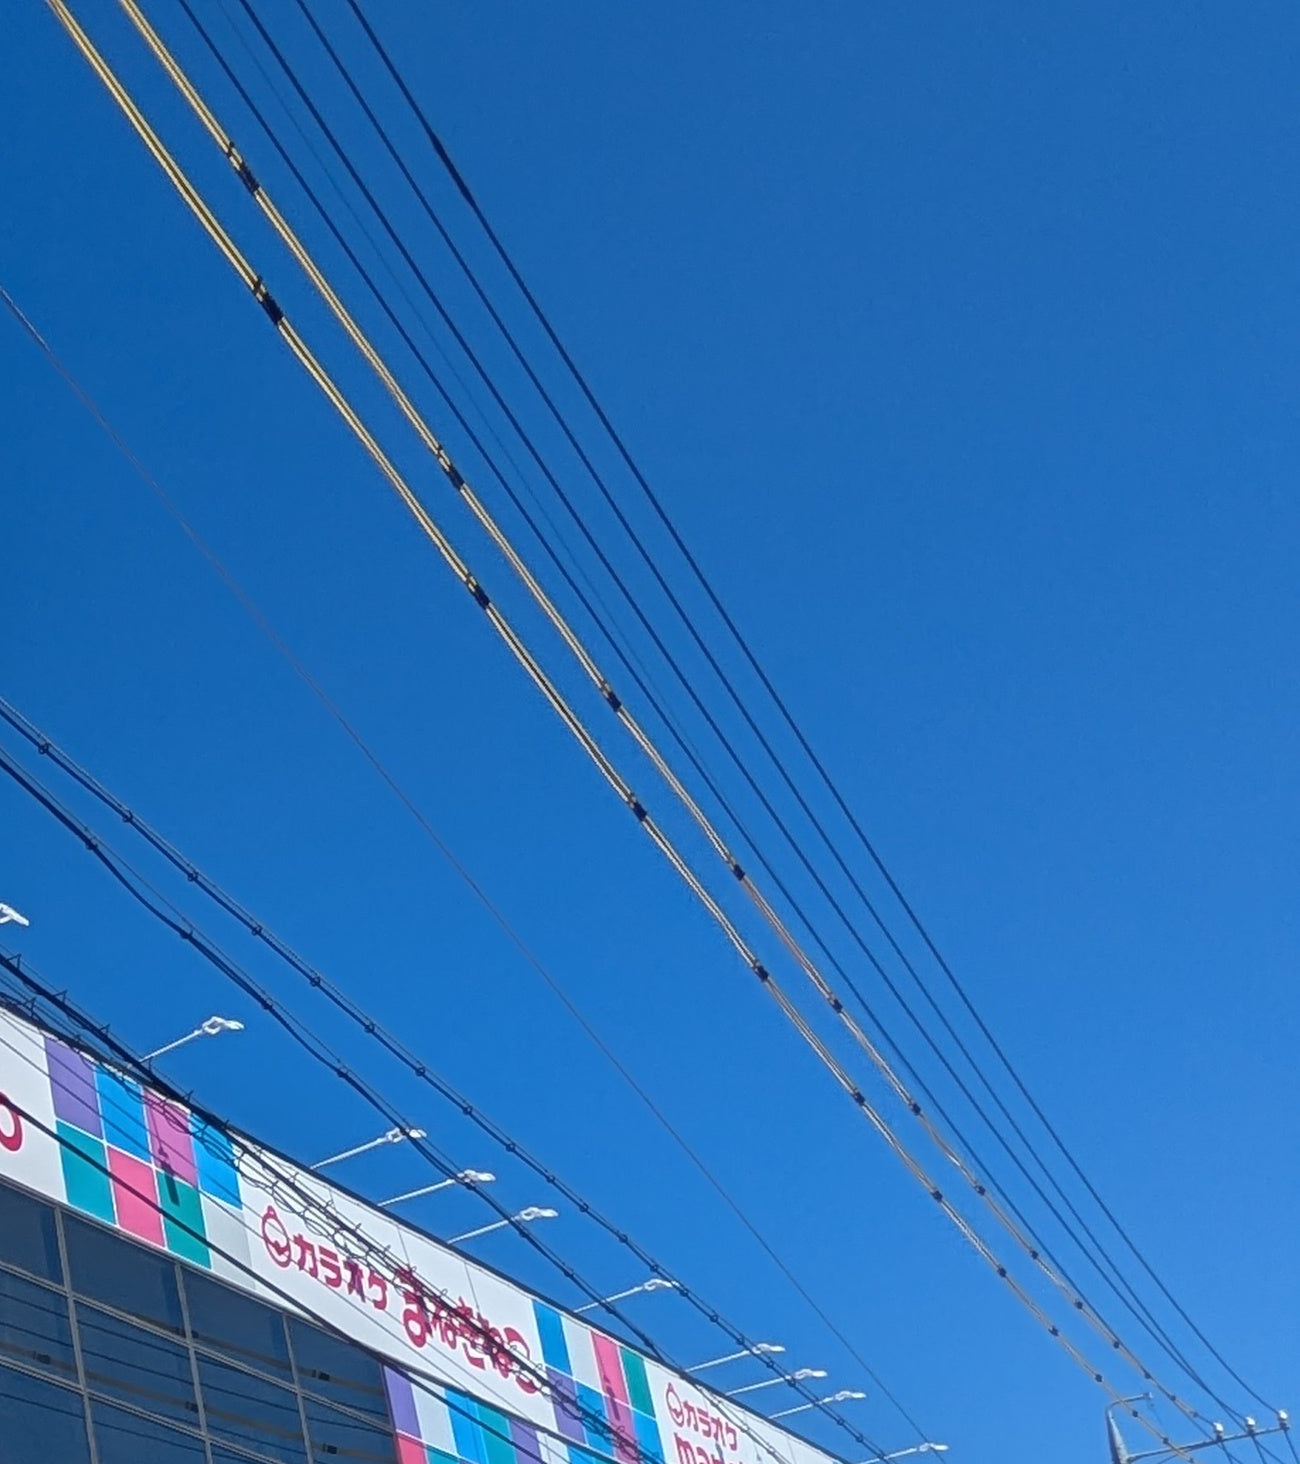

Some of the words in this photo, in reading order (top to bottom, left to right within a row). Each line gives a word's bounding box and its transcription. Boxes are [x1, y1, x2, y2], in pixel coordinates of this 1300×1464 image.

[294, 1233, 388, 1310] カラオケ
[683, 1400, 738, 1451] カラオケ
